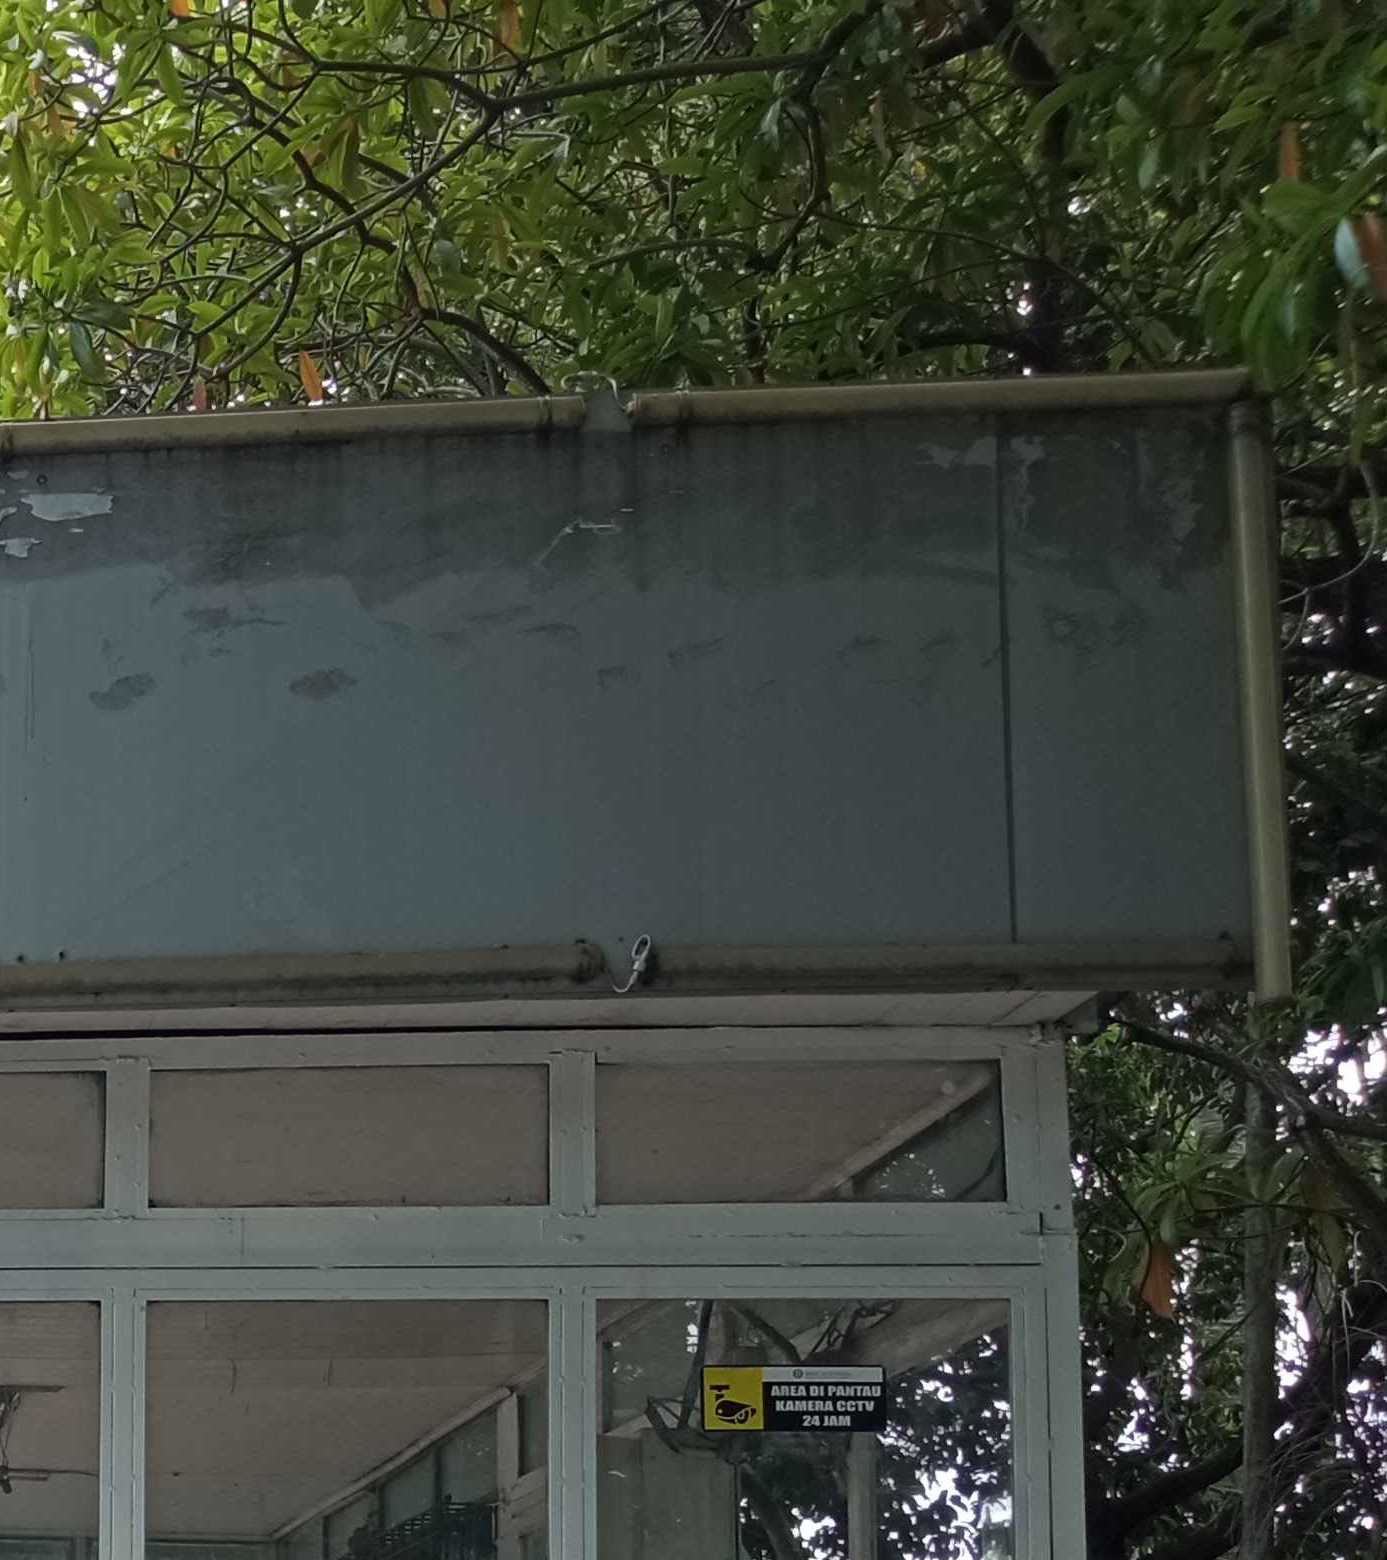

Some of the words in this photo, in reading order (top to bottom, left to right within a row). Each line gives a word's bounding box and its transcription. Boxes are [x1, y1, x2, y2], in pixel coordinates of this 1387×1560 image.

[771, 1385, 806, 1397] AREA
[809, 1385, 825, 1397] DI
[828, 1385, 881, 1397] PANTAU
[775, 1400, 834, 1412] KAMERA
[836, 1400, 875, 1412] CCTV
[802, 1415, 821, 1427] 24
[823, 1415, 851, 1427] JAM
